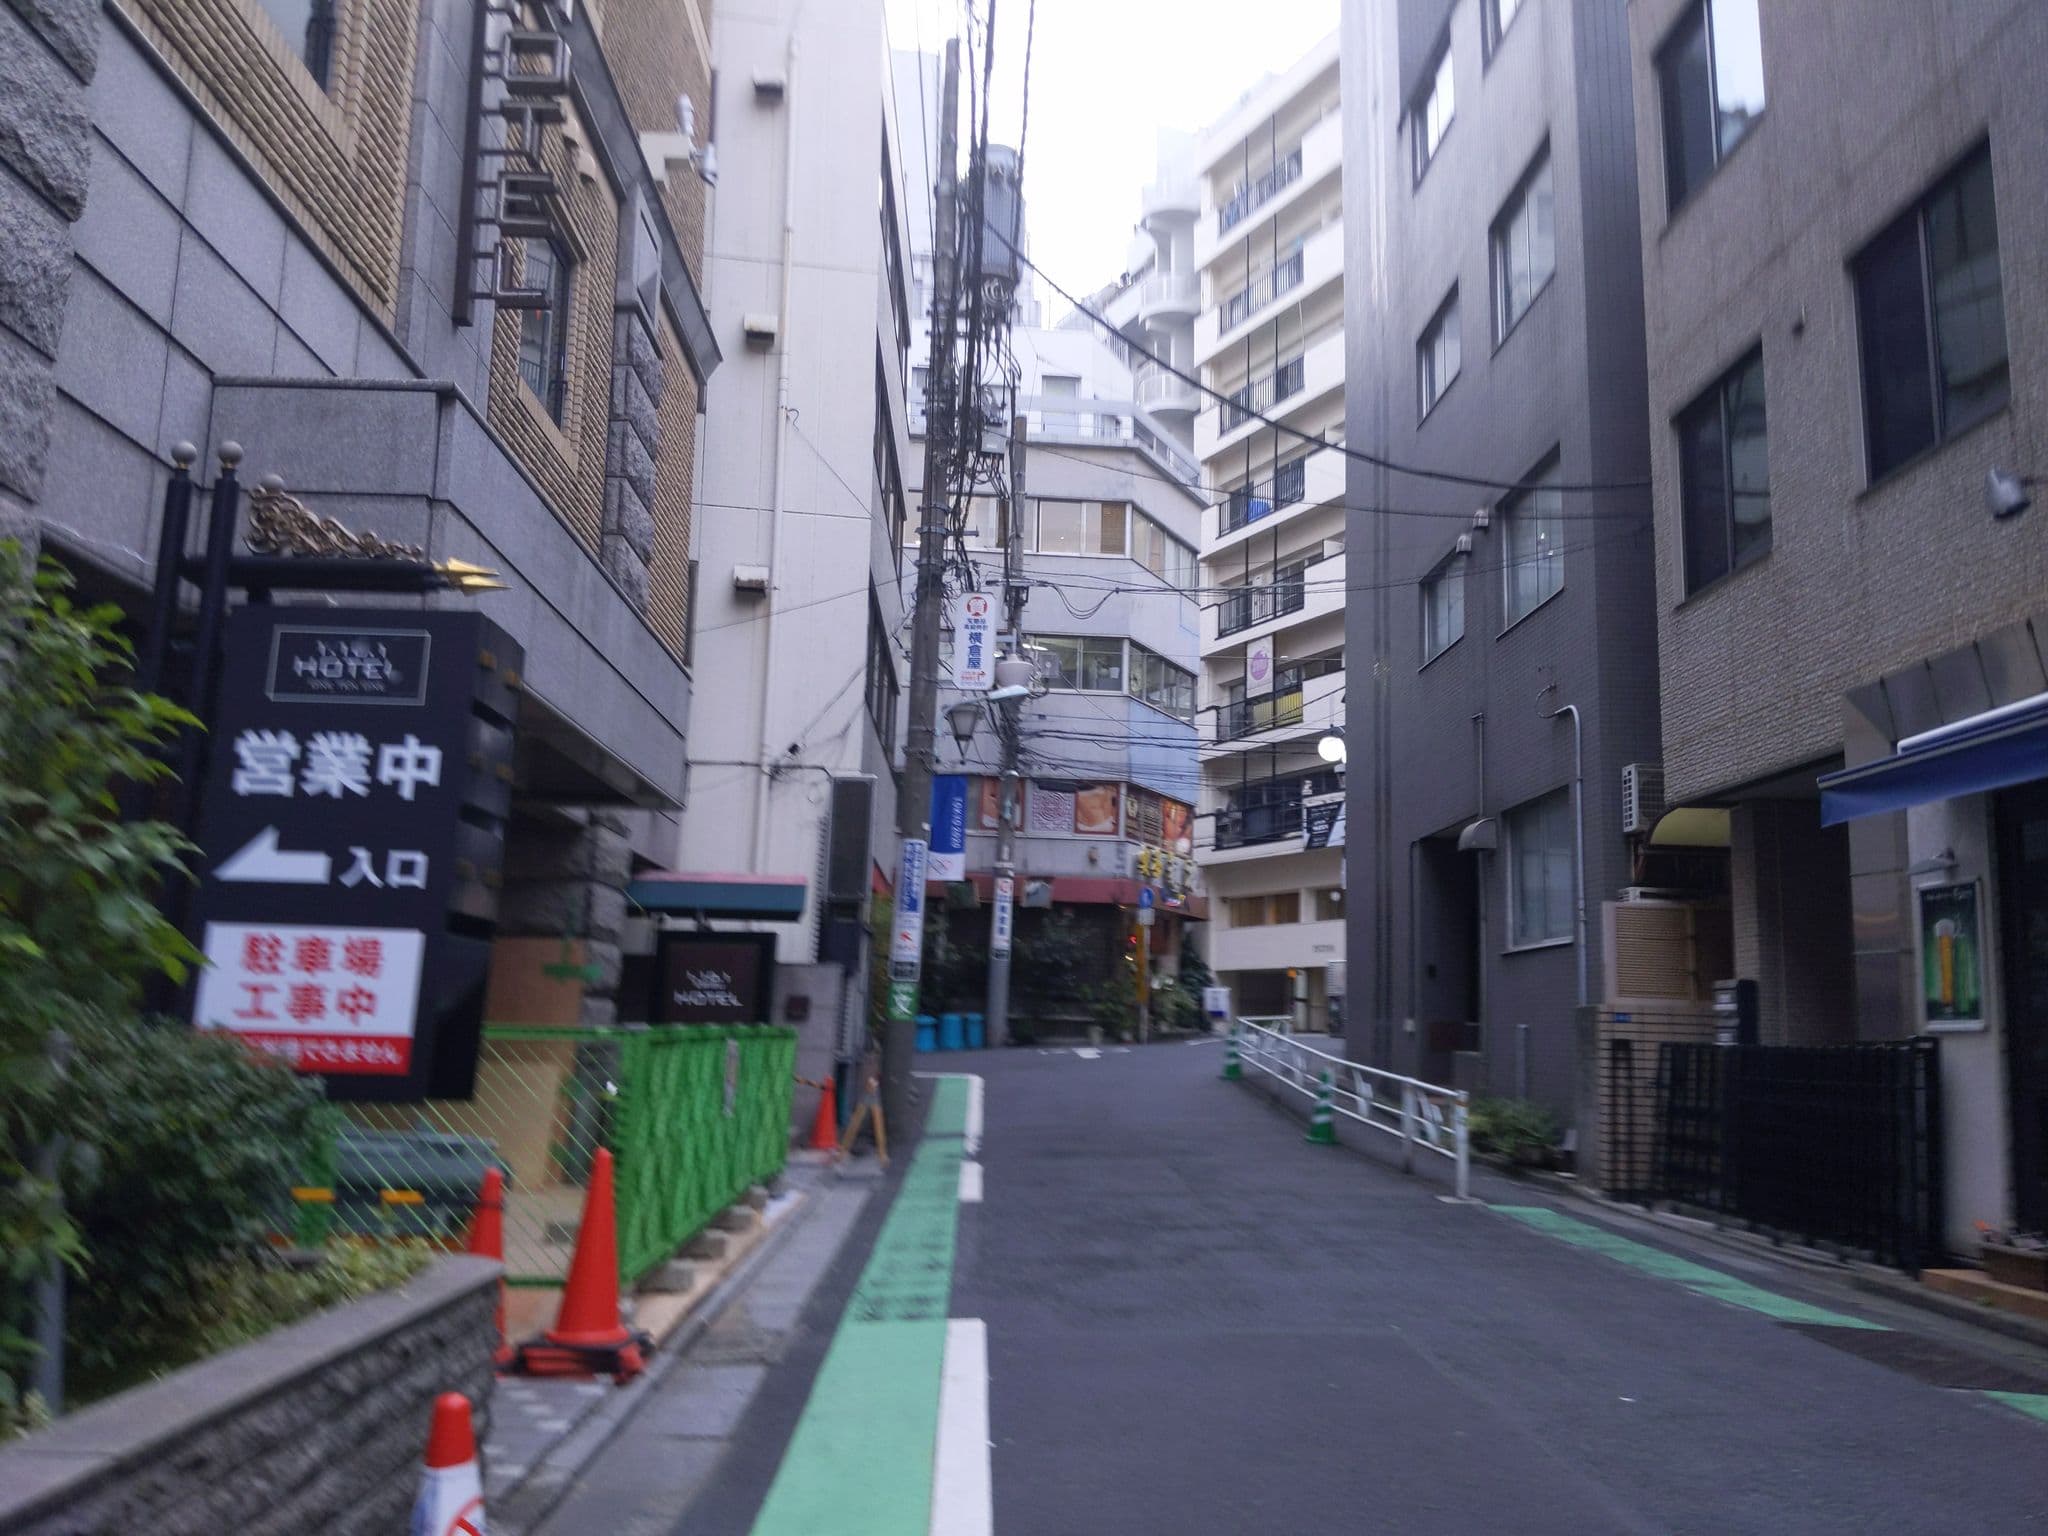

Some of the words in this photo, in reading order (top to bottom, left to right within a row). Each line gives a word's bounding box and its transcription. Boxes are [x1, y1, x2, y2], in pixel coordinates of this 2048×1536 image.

[293, 655, 394, 680] HOTEL
[968, 631, 983, 669] 横倉屋
[230, 728, 443, 801] 営業中
[337, 845, 430, 890] 入口
[241, 932, 384, 979] 駐車場
[232, 981, 379, 1027] 工事中
